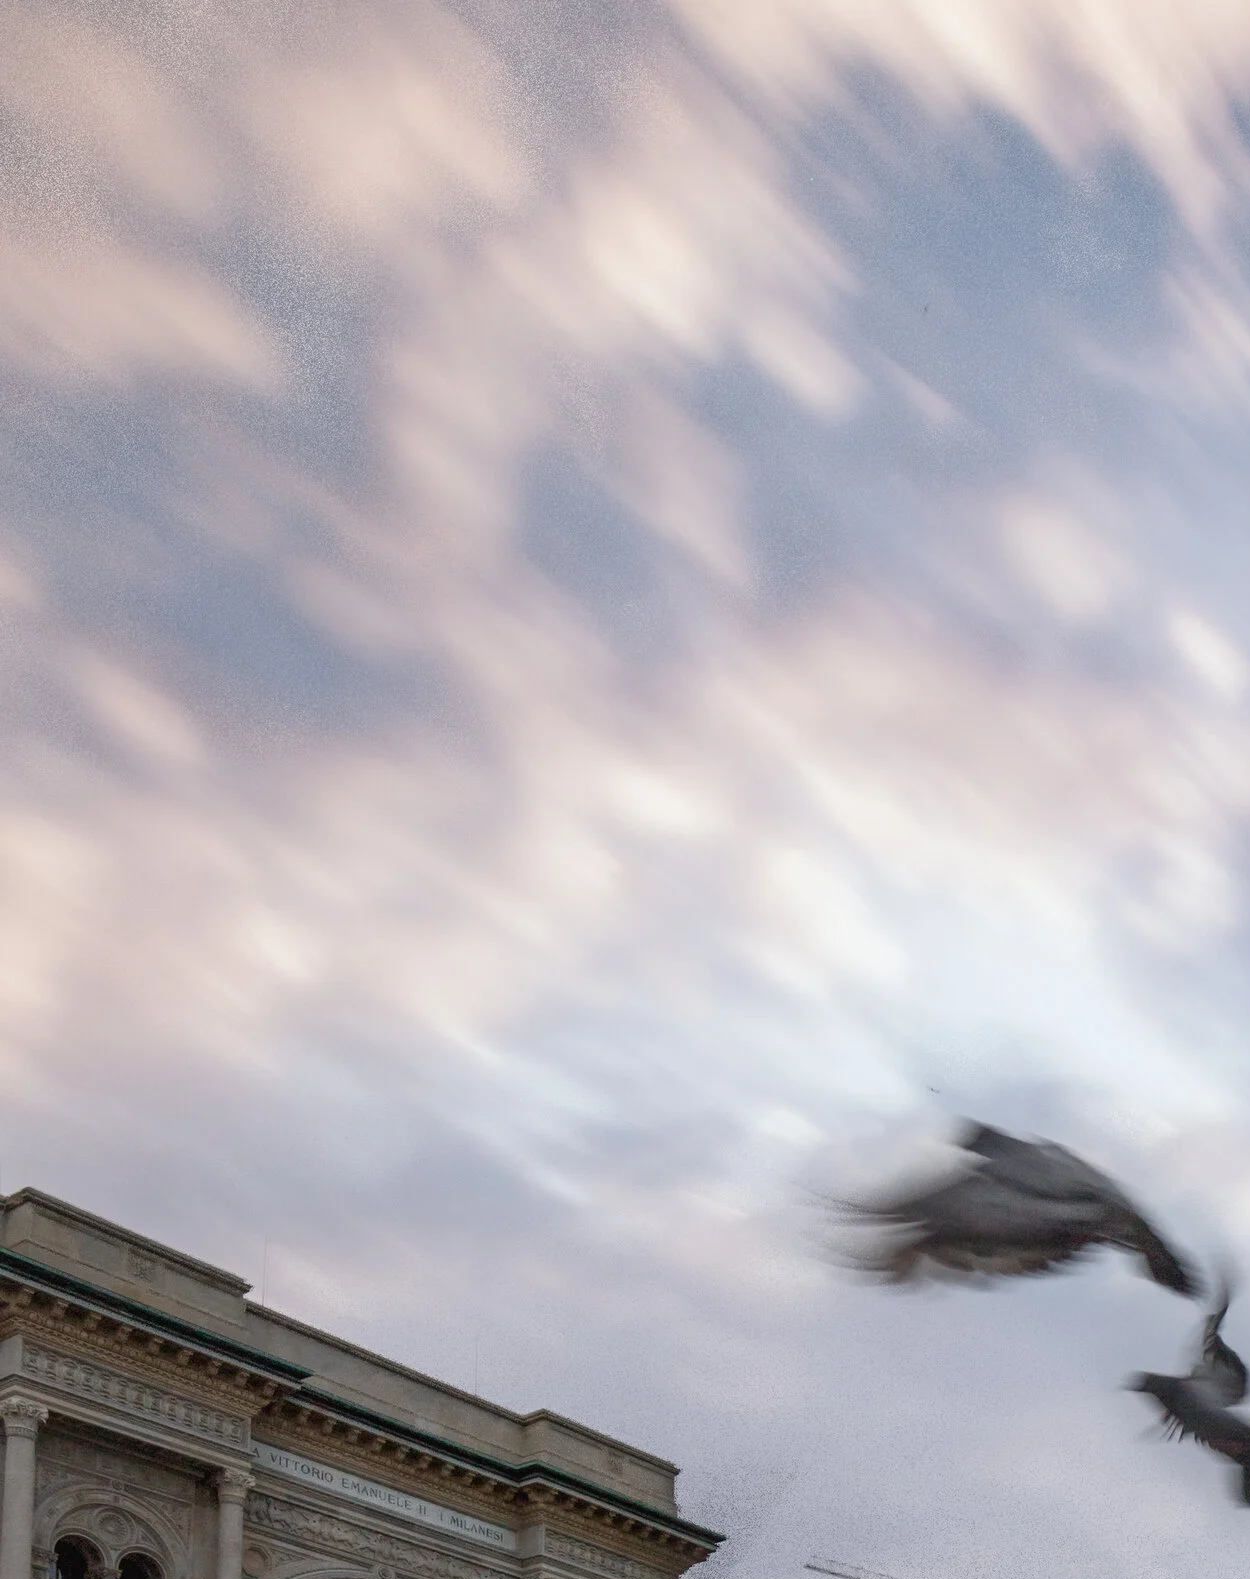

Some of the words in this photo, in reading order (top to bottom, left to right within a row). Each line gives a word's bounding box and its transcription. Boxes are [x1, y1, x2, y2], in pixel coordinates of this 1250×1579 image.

[253, 1447, 260, 1458] A
[269, 1452, 333, 1483] VITTORIO
[342, 1477, 413, 1510] EMANUELE
[450, 1515, 503, 1542] MILANESI
